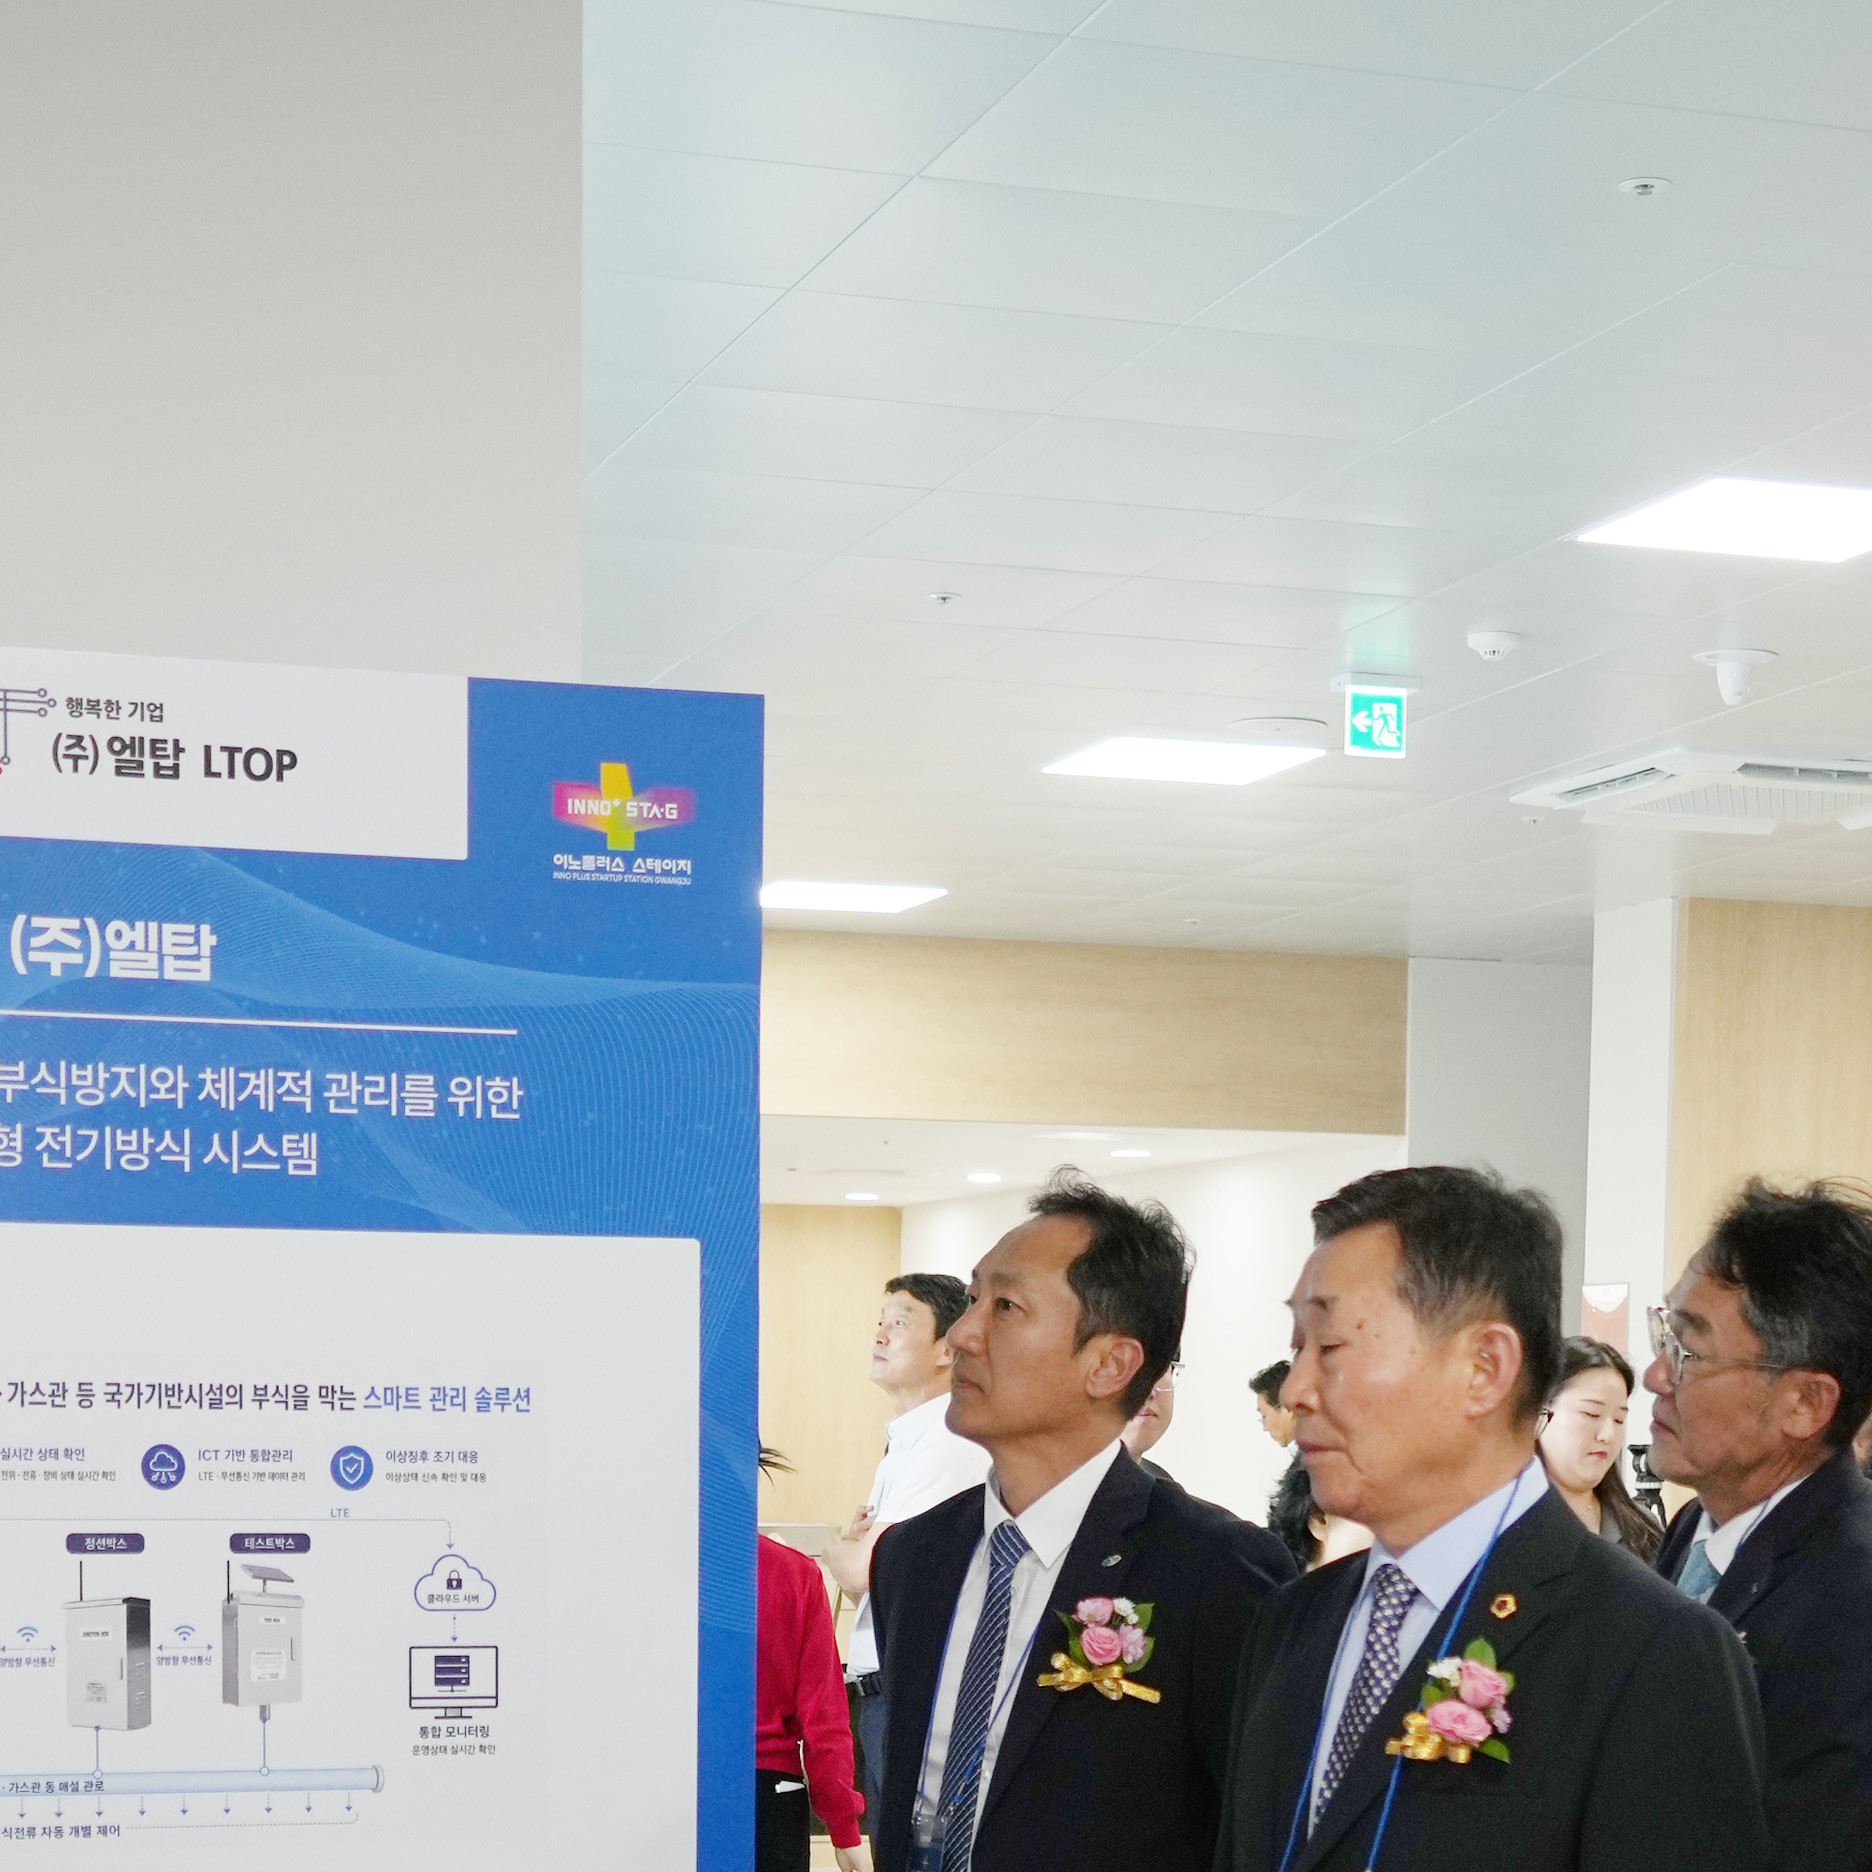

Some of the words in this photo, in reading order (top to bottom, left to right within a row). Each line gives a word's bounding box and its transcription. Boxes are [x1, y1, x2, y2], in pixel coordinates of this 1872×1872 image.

[65, 696, 123, 721] 행복한
[128, 701, 164, 724] 기업
[52, 732, 100, 775] (주)
[106, 735, 186, 780] 엘탑
[203, 744, 298, 783] LTOP
[553, 854, 625, 871] 이노플러스
[633, 858, 691, 875] 스테이지
[553, 872, 571, 880] INNO
[572, 873, 590, 881] PLUS
[591, 874, 622, 882] STARTUP
[624, 875, 653, 883] STATION
[655, 877, 691, 885] GWANGJU
[10, 914, 217, 982] (주)엘탑
[197, 1066, 312, 1114] 체계적
[323, 1071, 439, 1117] 관리를
[446, 1075, 524, 1119] 위한
[35, 1124, 191, 1173] 전기방식
[202, 1129, 318, 1176] 시스템
[76, 1381, 95, 1409] 등
[103, 1381, 244, 1411] 국가기반시설의
[251, 1383, 310, 1412] 부식을
[319, 1384, 357, 1412] 막는
[363, 1386, 421, 1412] 스마트
[430, 1386, 467, 1413] 관리
[474, 1386, 531, 1413] 솔루션
[0, 1447, 34, 1461] 실시간
[37, 1448, 59, 1461] 상태
[63, 1448, 85, 1461] 확인
[198, 1450, 219, 1461] ICT
[225, 1449, 246, 1462] 기반
[249, 1449, 293, 1463] 통합관리
[386, 1450, 428, 1464] 이상징후
[433, 1451, 455, 1464] 조기
[458, 1451, 479, 1464] 대응
[198, 1472, 213, 1482] LTE
[330, 1508, 350, 1518] LTE
[84, 1537, 127, 1550] 정션박스
[244, 1537, 295, 1550] 테스트박스
[427, 1594, 460, 1604] 클라우드
[463, 1594, 479, 1604] 서버
[419, 1726, 441, 1739] 통합
[446, 1726, 489, 1739] 모니터링
[412, 1745, 447, 1755] 운영상태
[450, 1745, 476, 1755] 실시간
[479, 1745, 496, 1754] 확인
[9, 1782, 41, 1794] 가스관
[83, 1781, 104, 1792] 관로
[41, 1826, 65, 1839] 자동
[68, 1825, 92, 1838] 개별
[96, 1825, 121, 1838] 제어
